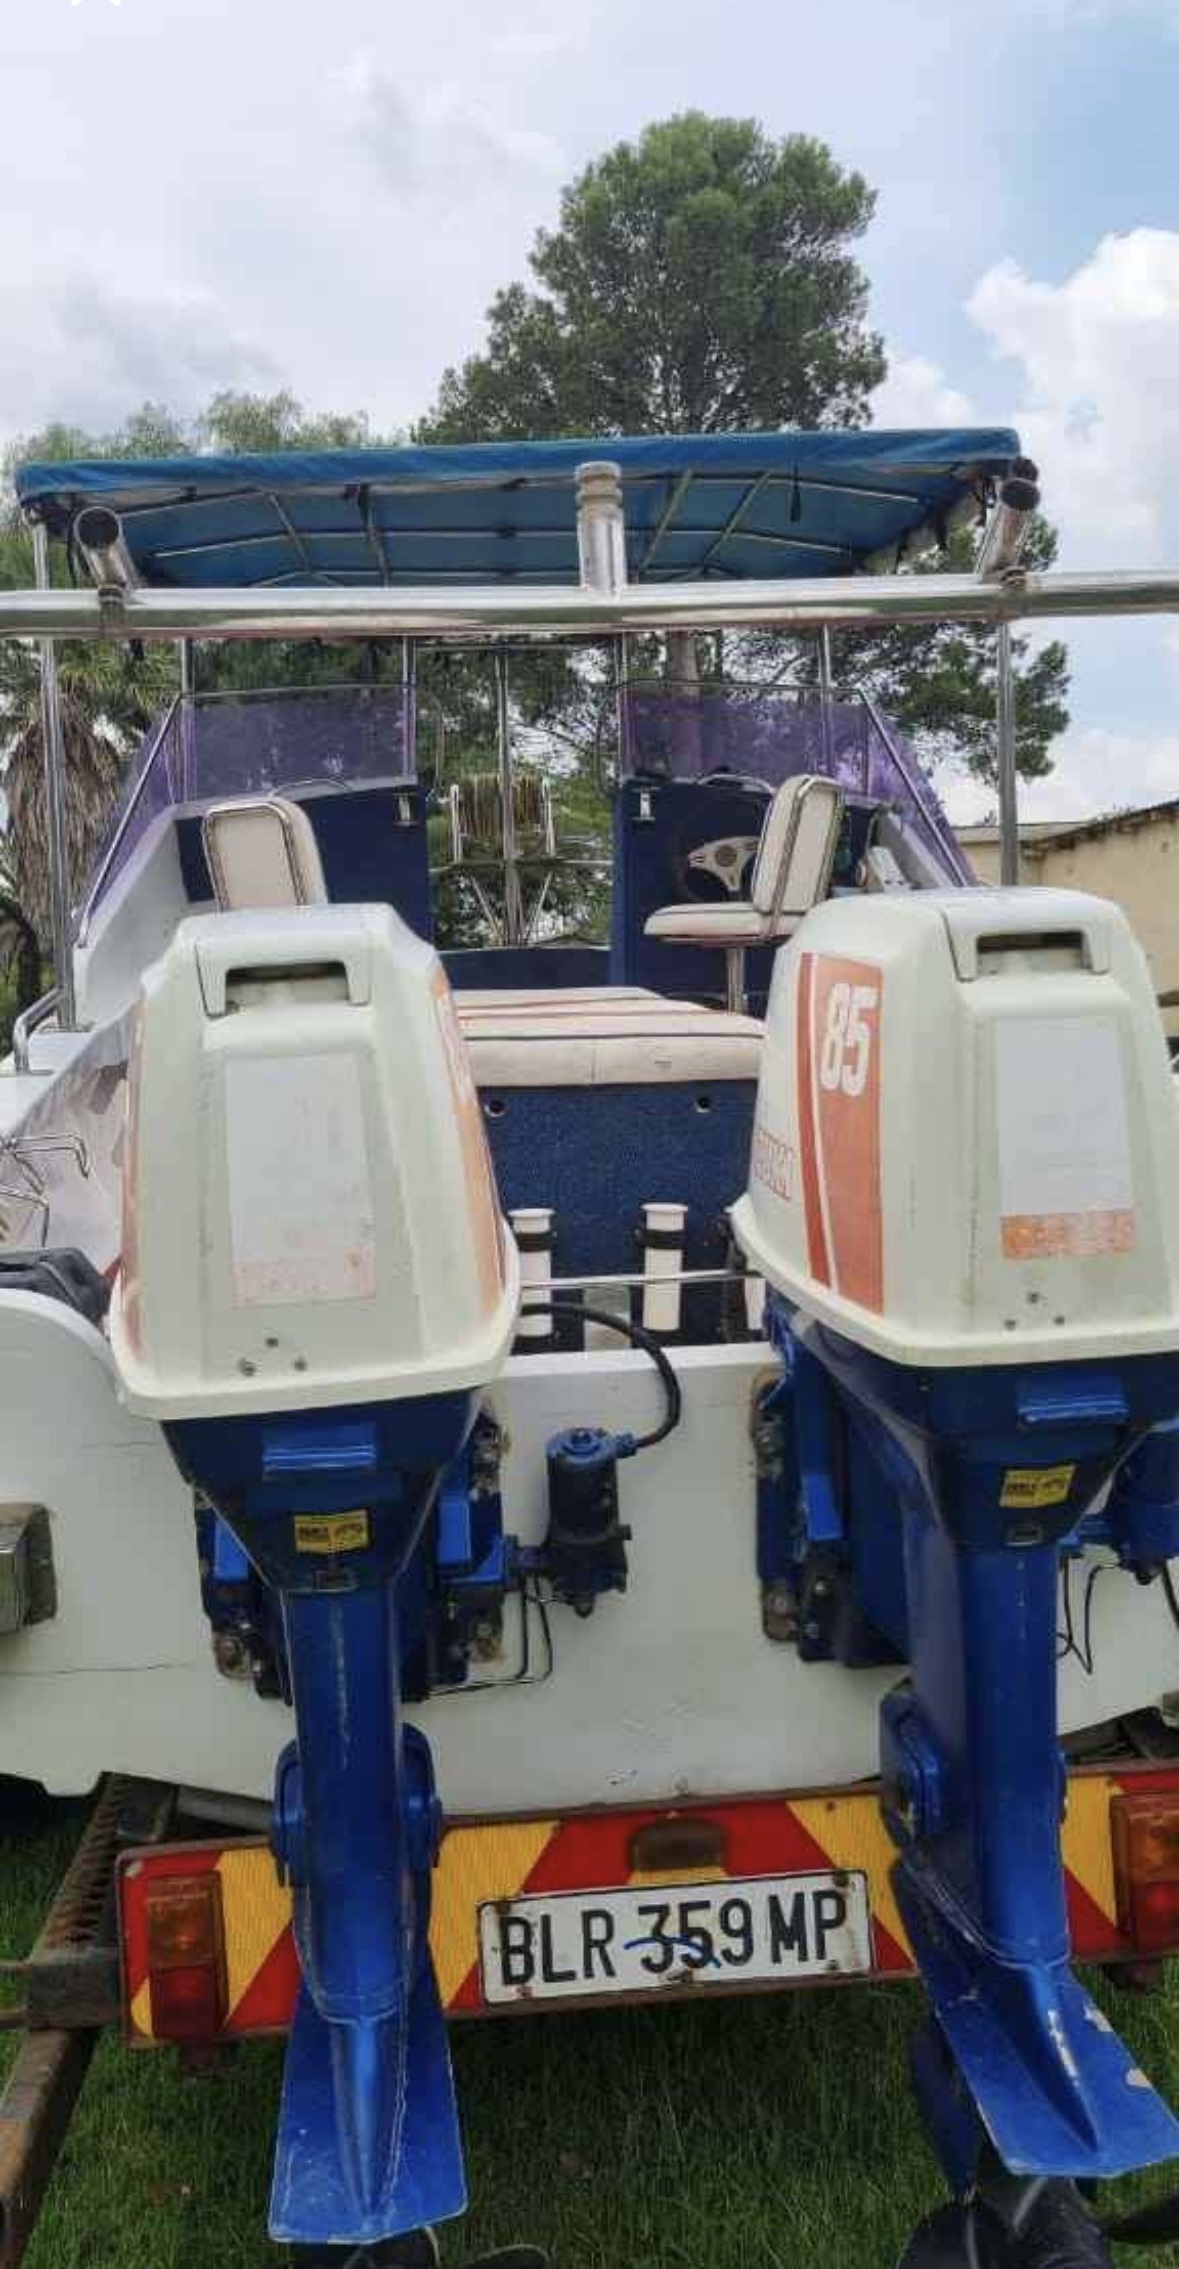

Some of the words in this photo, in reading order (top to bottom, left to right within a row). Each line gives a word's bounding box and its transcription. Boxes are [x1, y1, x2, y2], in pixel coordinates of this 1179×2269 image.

[820, 982, 879, 1096] 85
[501, 1908, 616, 1986] BLR
[637, 1898, 754, 1974] 359
[768, 1889, 847, 1964] MP
